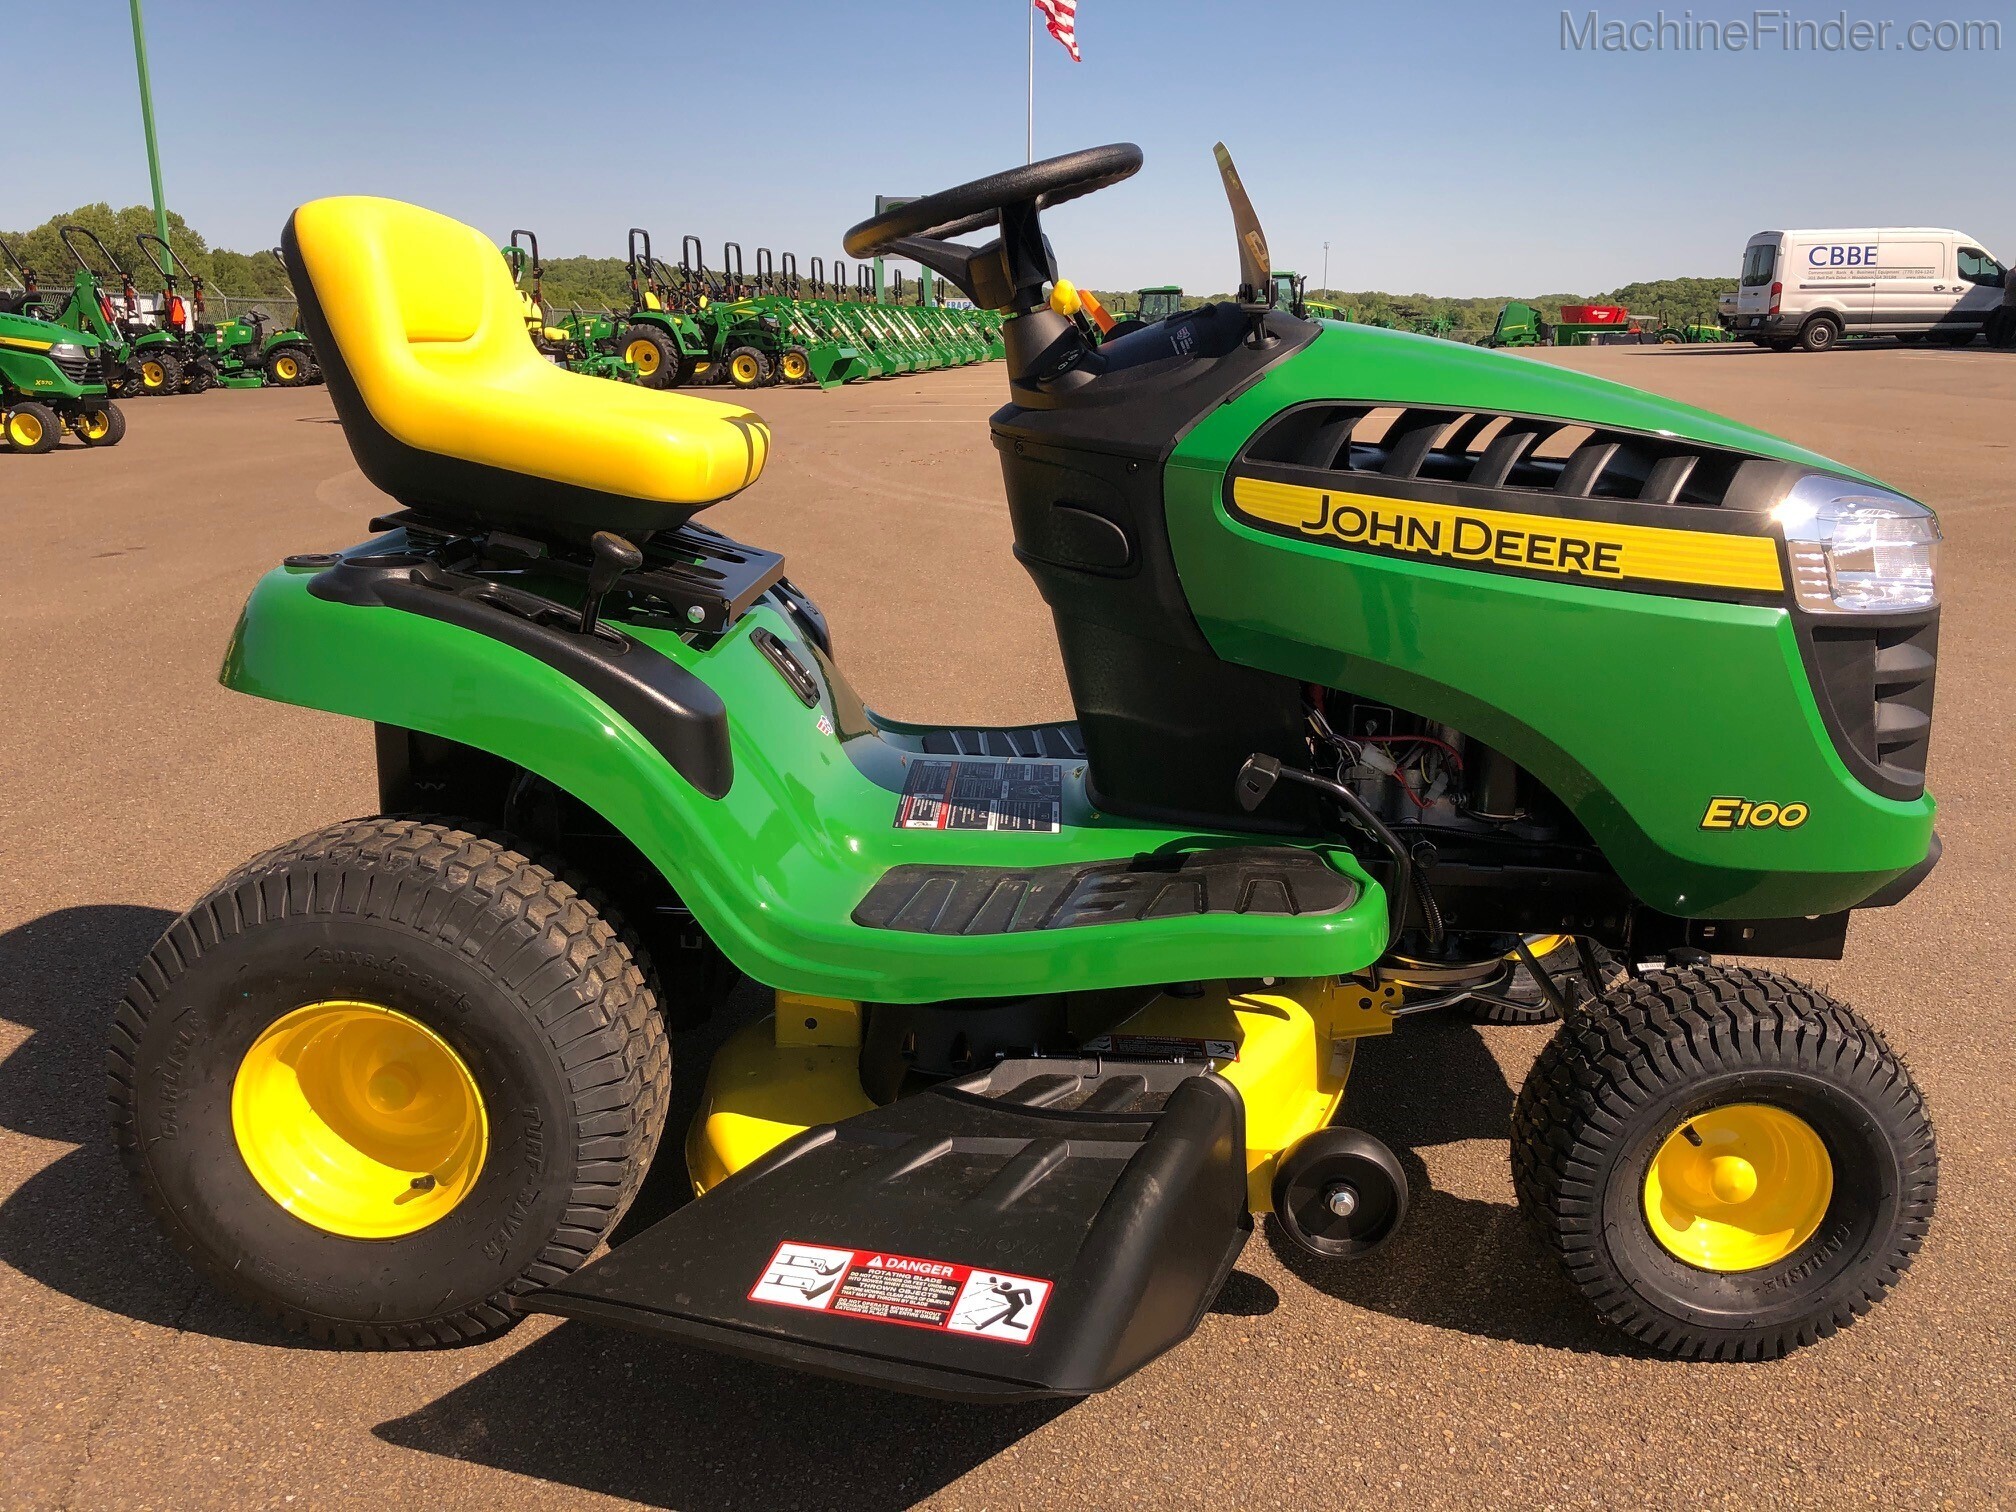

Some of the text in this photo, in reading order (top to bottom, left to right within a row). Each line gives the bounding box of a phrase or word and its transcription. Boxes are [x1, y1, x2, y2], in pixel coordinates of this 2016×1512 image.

[1808, 246, 1877, 266] CBBE
[1301, 494, 1624, 574] JOHN DEERE
[1700, 797, 1809, 829] E100
[886, 1258, 954, 1277] DANGER
[868, 1268, 943, 1284] ROTATING BLADE
[860, 1282, 938, 1299] THROWN OBJECTS
[901, 1283, 922, 1291] ENGINE
[929, 1287, 955, 1296] RUNNING
[877, 1294, 900, 1302] THROWN
[926, 1298, 951, 1306] OBJECTS
[914, 1309, 942, 1317] WITHOUT
